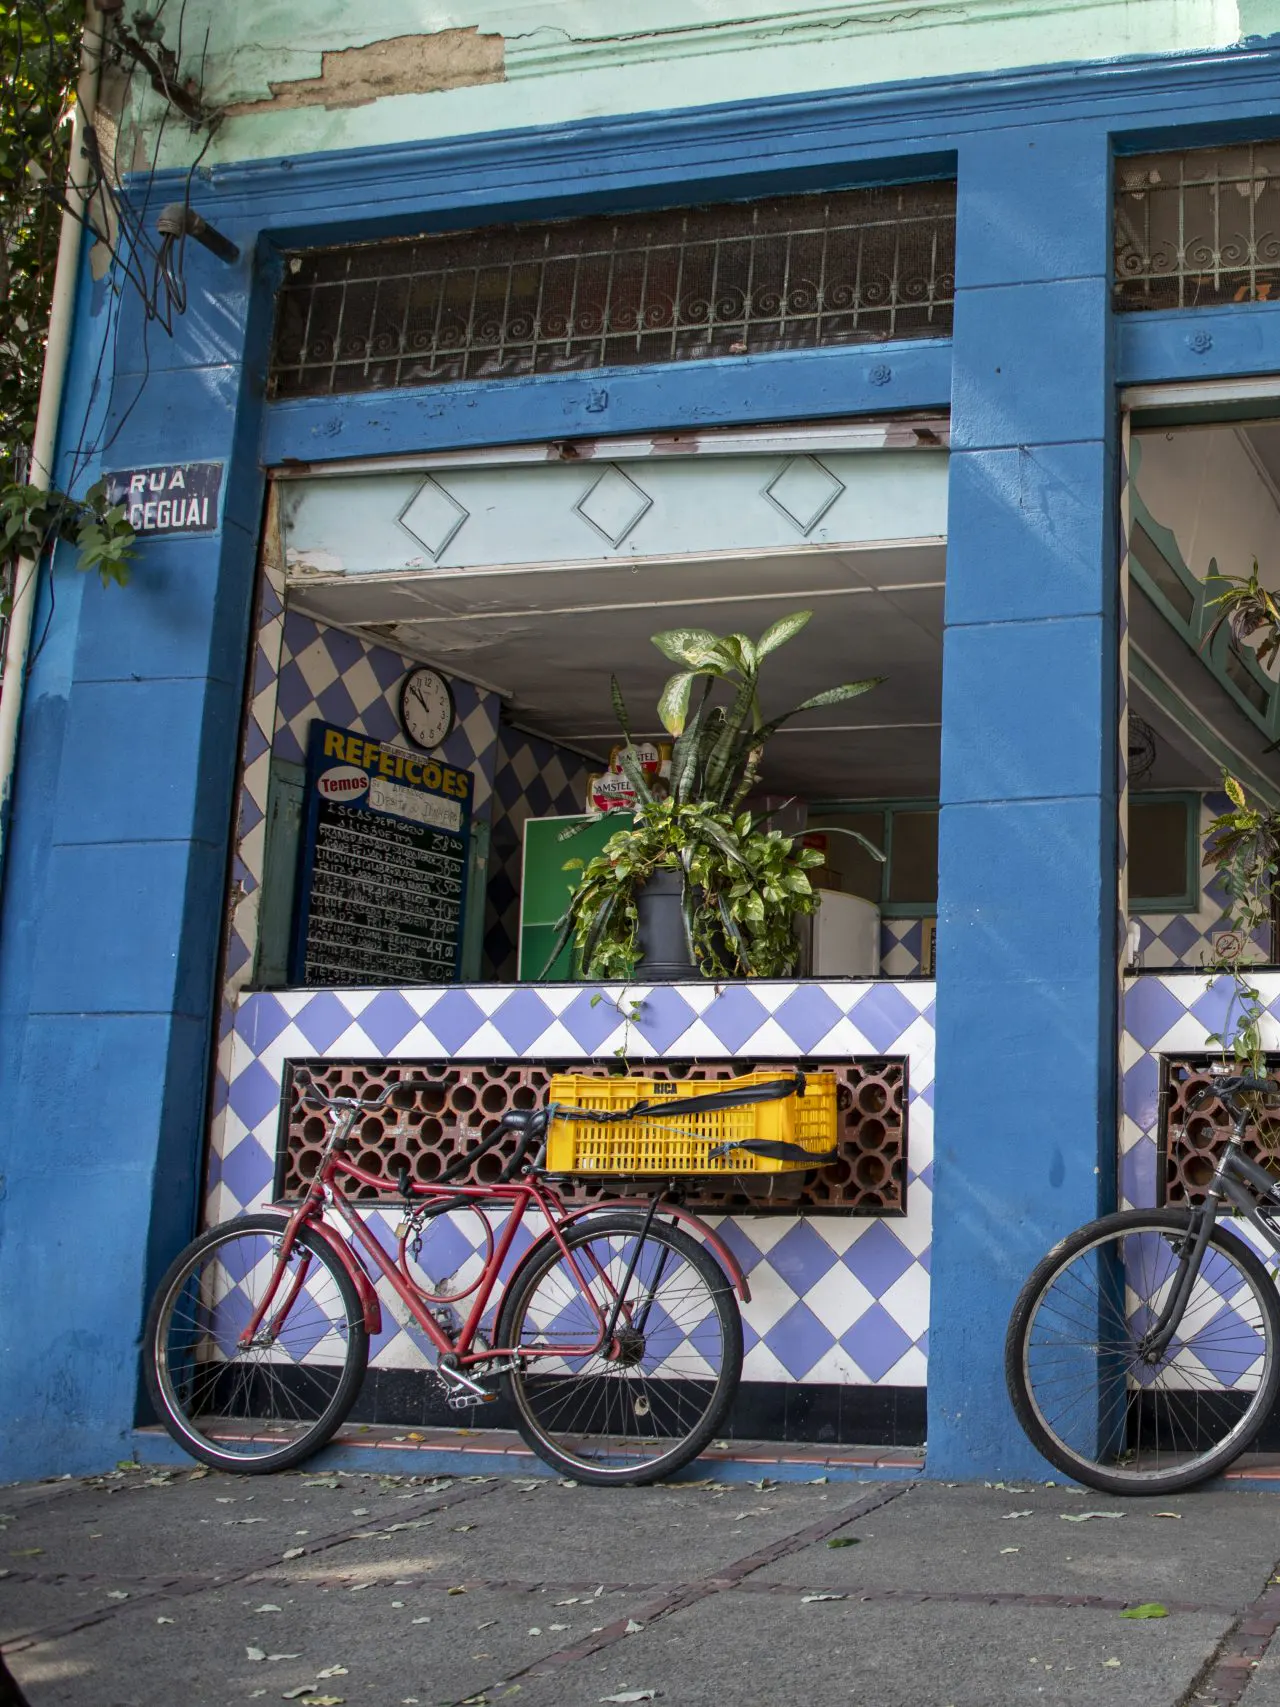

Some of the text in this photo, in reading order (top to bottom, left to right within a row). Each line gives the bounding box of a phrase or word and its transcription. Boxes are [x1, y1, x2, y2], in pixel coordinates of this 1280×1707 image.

[130, 470, 186, 493] RUA
[321, 777, 368, 793] Temos
[653, 1082, 678, 1095] RICA
